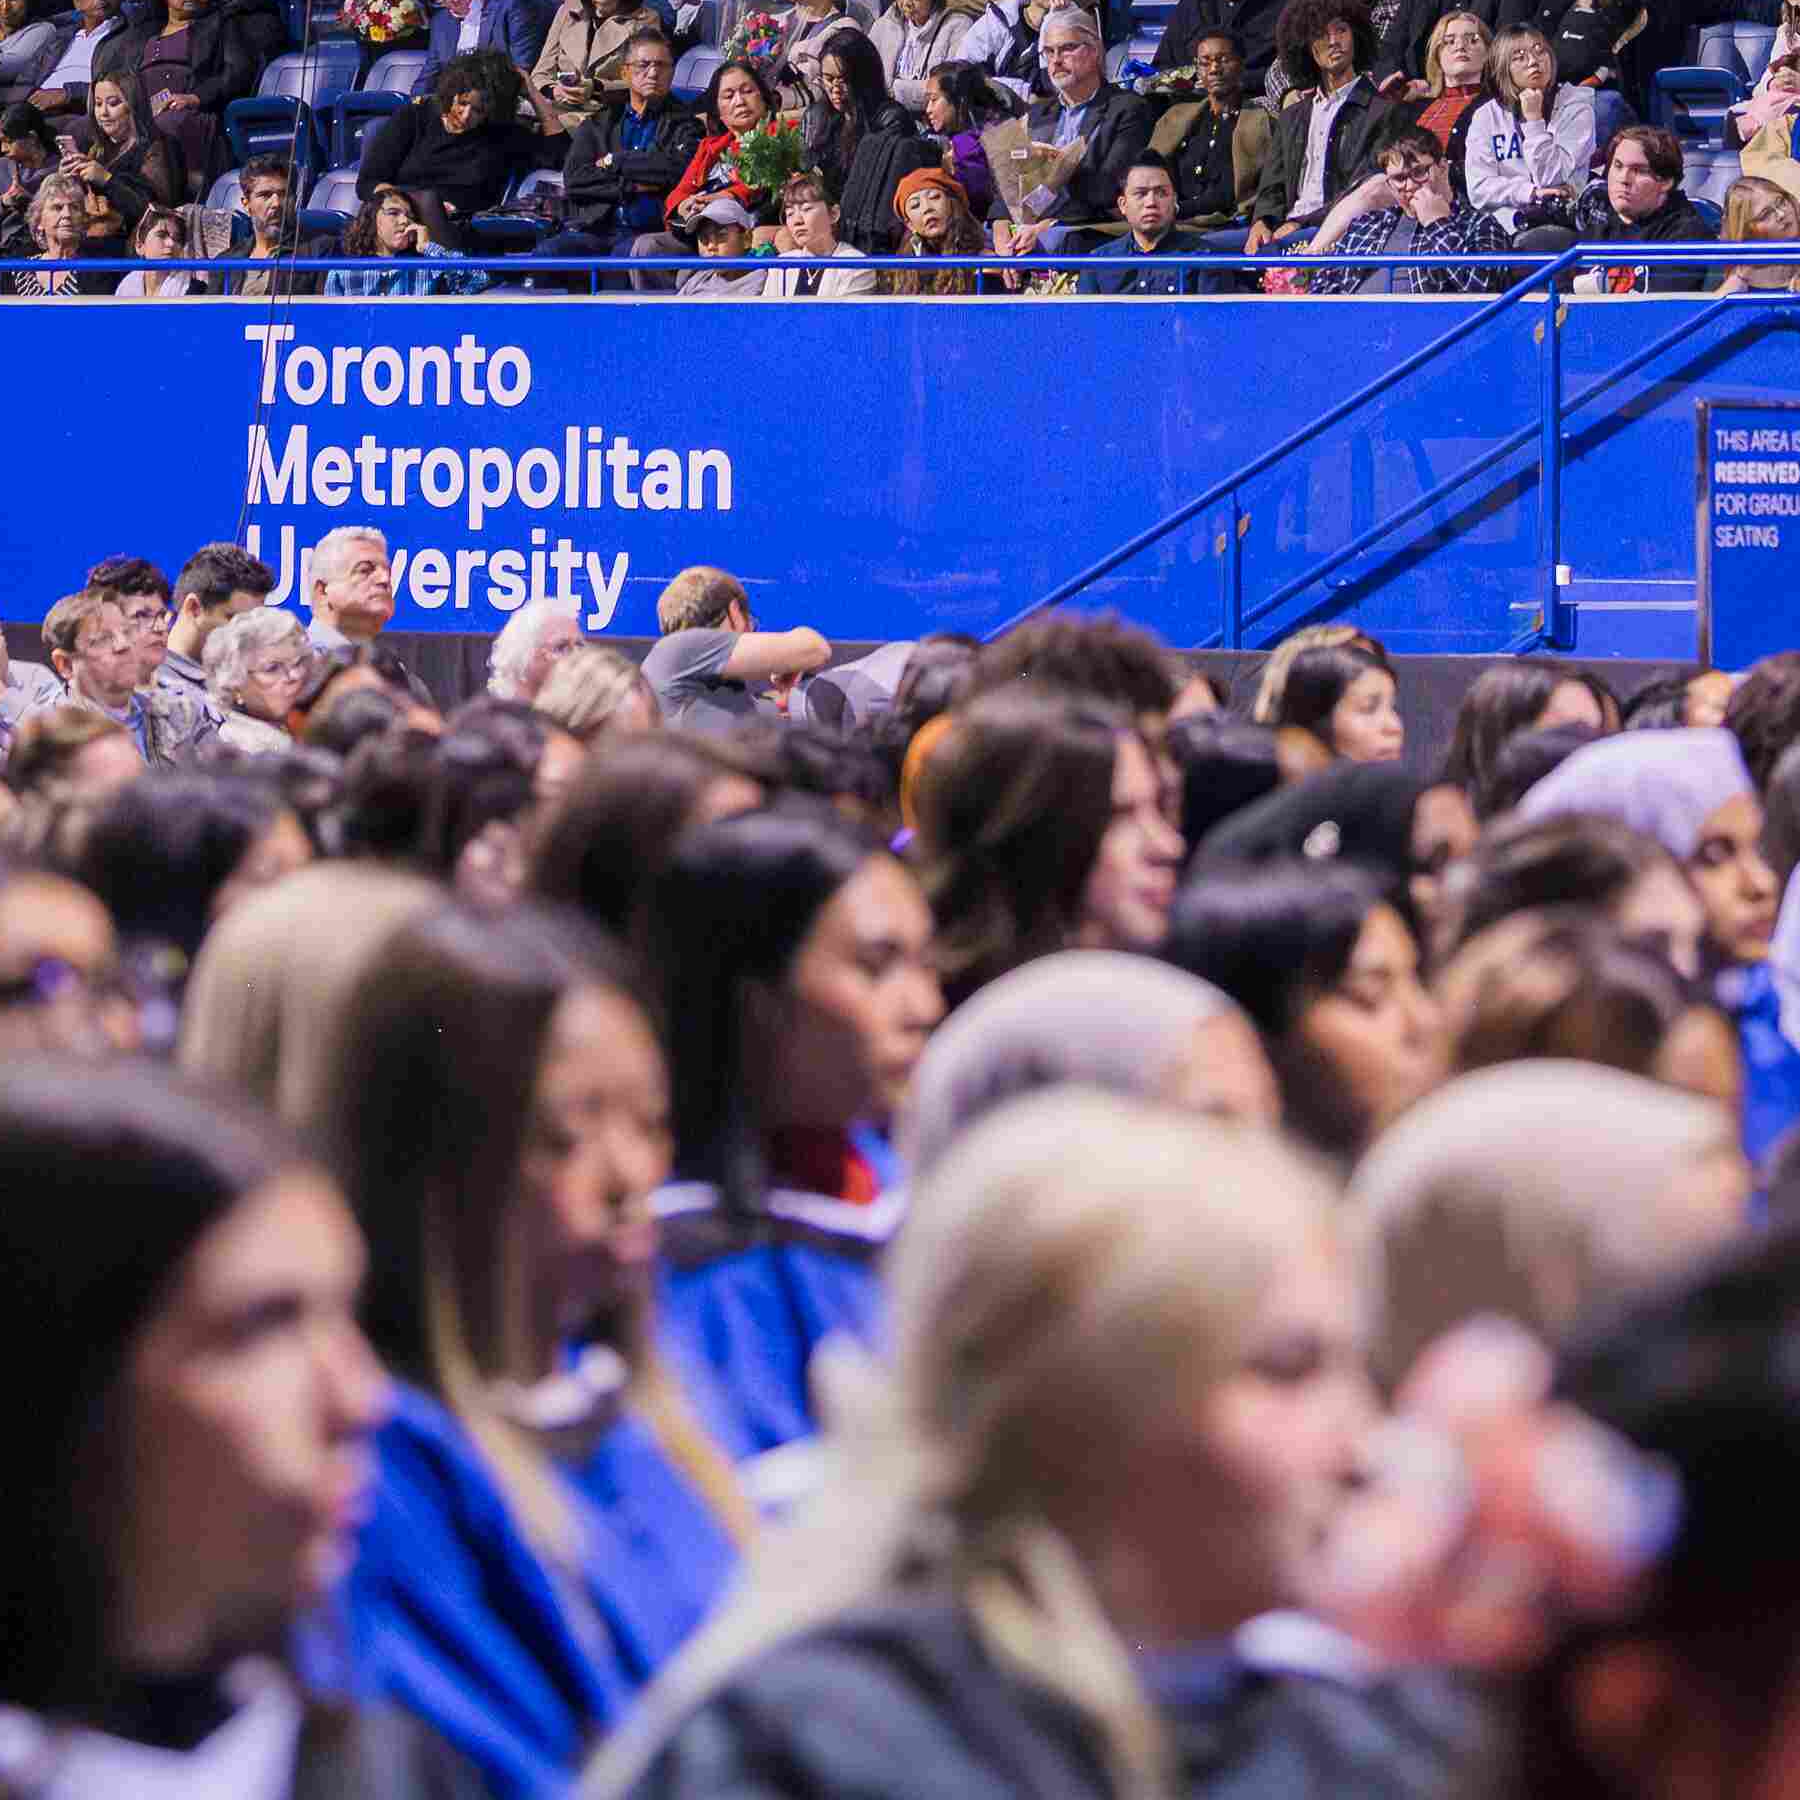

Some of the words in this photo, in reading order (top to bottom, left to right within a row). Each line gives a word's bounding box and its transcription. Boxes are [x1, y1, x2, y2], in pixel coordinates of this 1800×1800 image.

[245, 324, 532, 407] Toronto
[1715, 429, 1749, 453] THIS
[1750, 429, 1791, 453] AREA
[248, 425, 733, 530] Metropolitan
[1715, 461, 1800, 485] RESERVED
[1715, 492, 1747, 516] FOR
[1715, 524, 1780, 549] SEATING
[247, 525, 629, 631] Uersity
